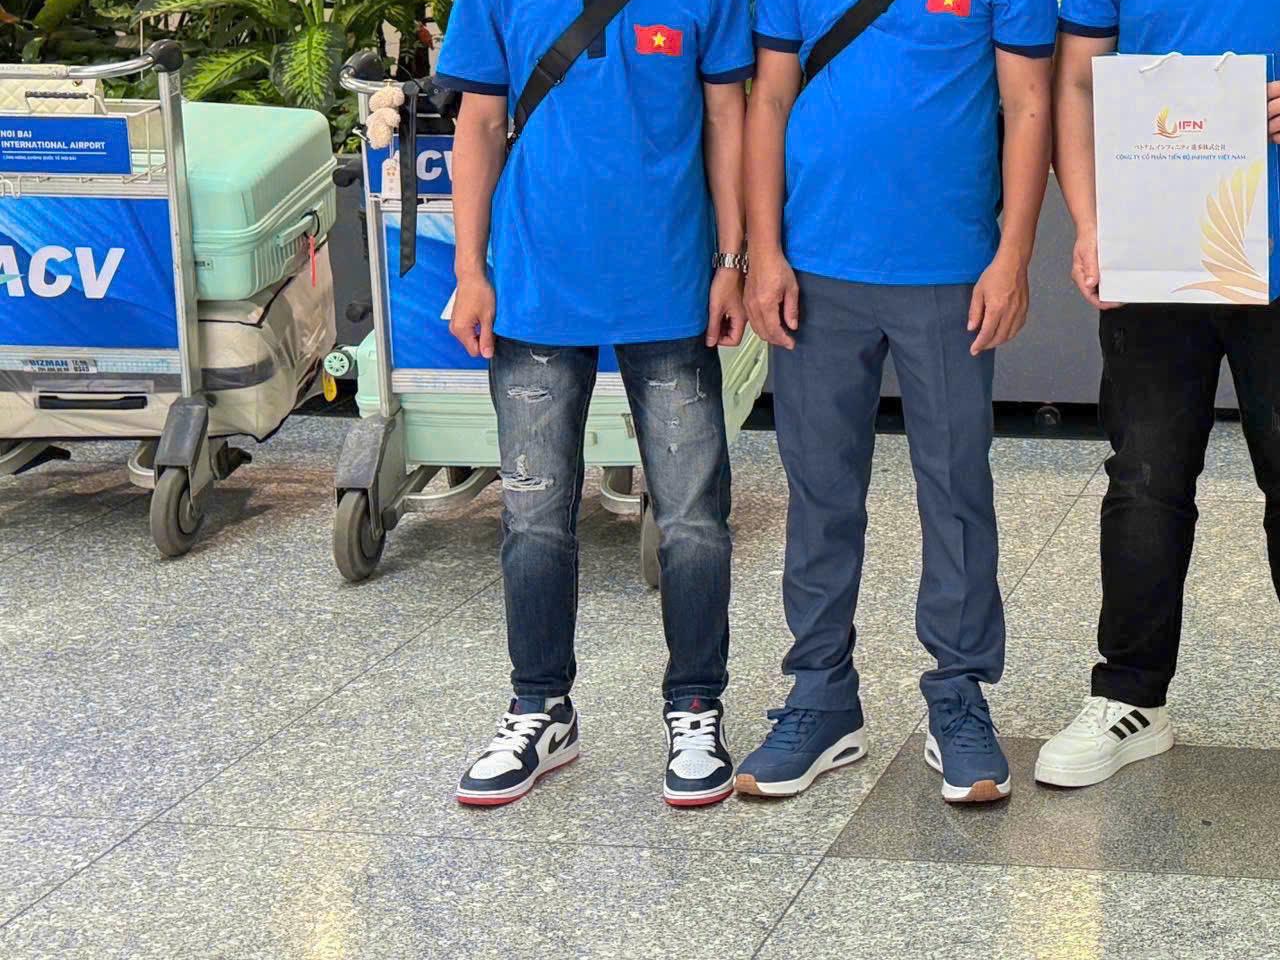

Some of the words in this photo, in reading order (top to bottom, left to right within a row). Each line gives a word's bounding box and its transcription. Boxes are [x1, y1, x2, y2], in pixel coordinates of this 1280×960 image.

[1178, 121, 1204, 130] IFN
[1, 140, 68, 149] INTERNATIONAL
[69, 141, 106, 150] AIRPORT
